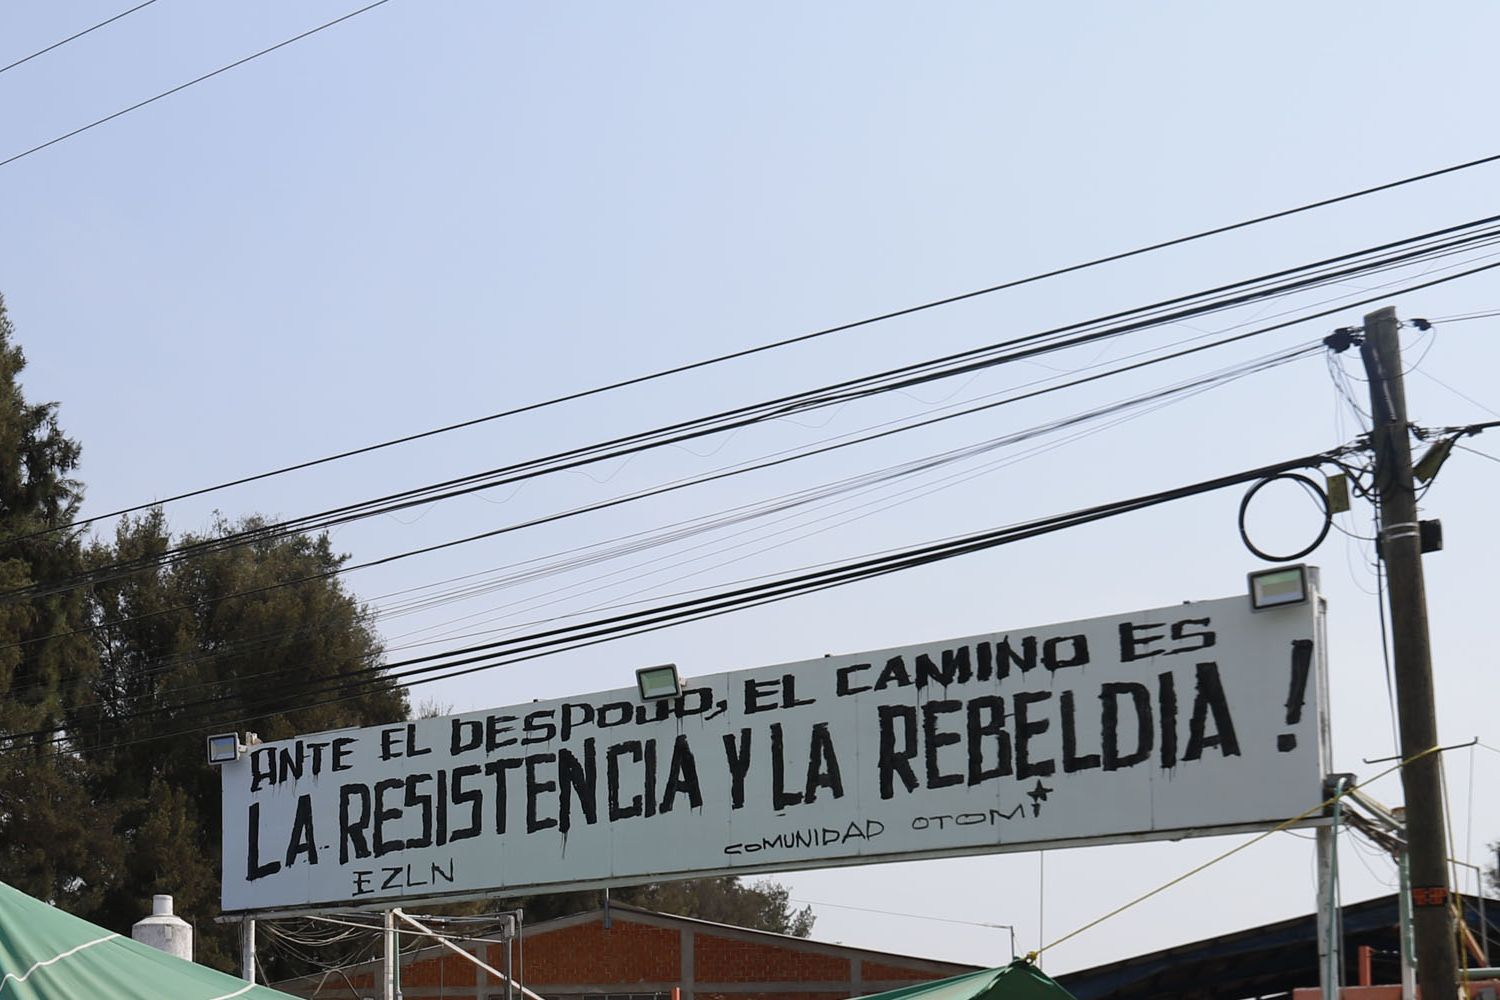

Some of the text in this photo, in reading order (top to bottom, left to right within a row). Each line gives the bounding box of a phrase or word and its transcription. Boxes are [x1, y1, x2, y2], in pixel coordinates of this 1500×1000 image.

[247, 794, 318, 881] LA
[339, 734, 704, 865] RESISTENCIA
[723, 728, 752, 811] Y
[770, 722, 845, 811] LA
[878, 661, 1242, 800] REBELDIA
[250, 737, 357, 791] ANTE
[380, 727, 432, 761] EL
[744, 674, 816, 714] EL
[837, 634, 1090, 698] CAMINO
[1119, 617, 1217, 663] ES
[352, 857, 454, 897] EZLN
